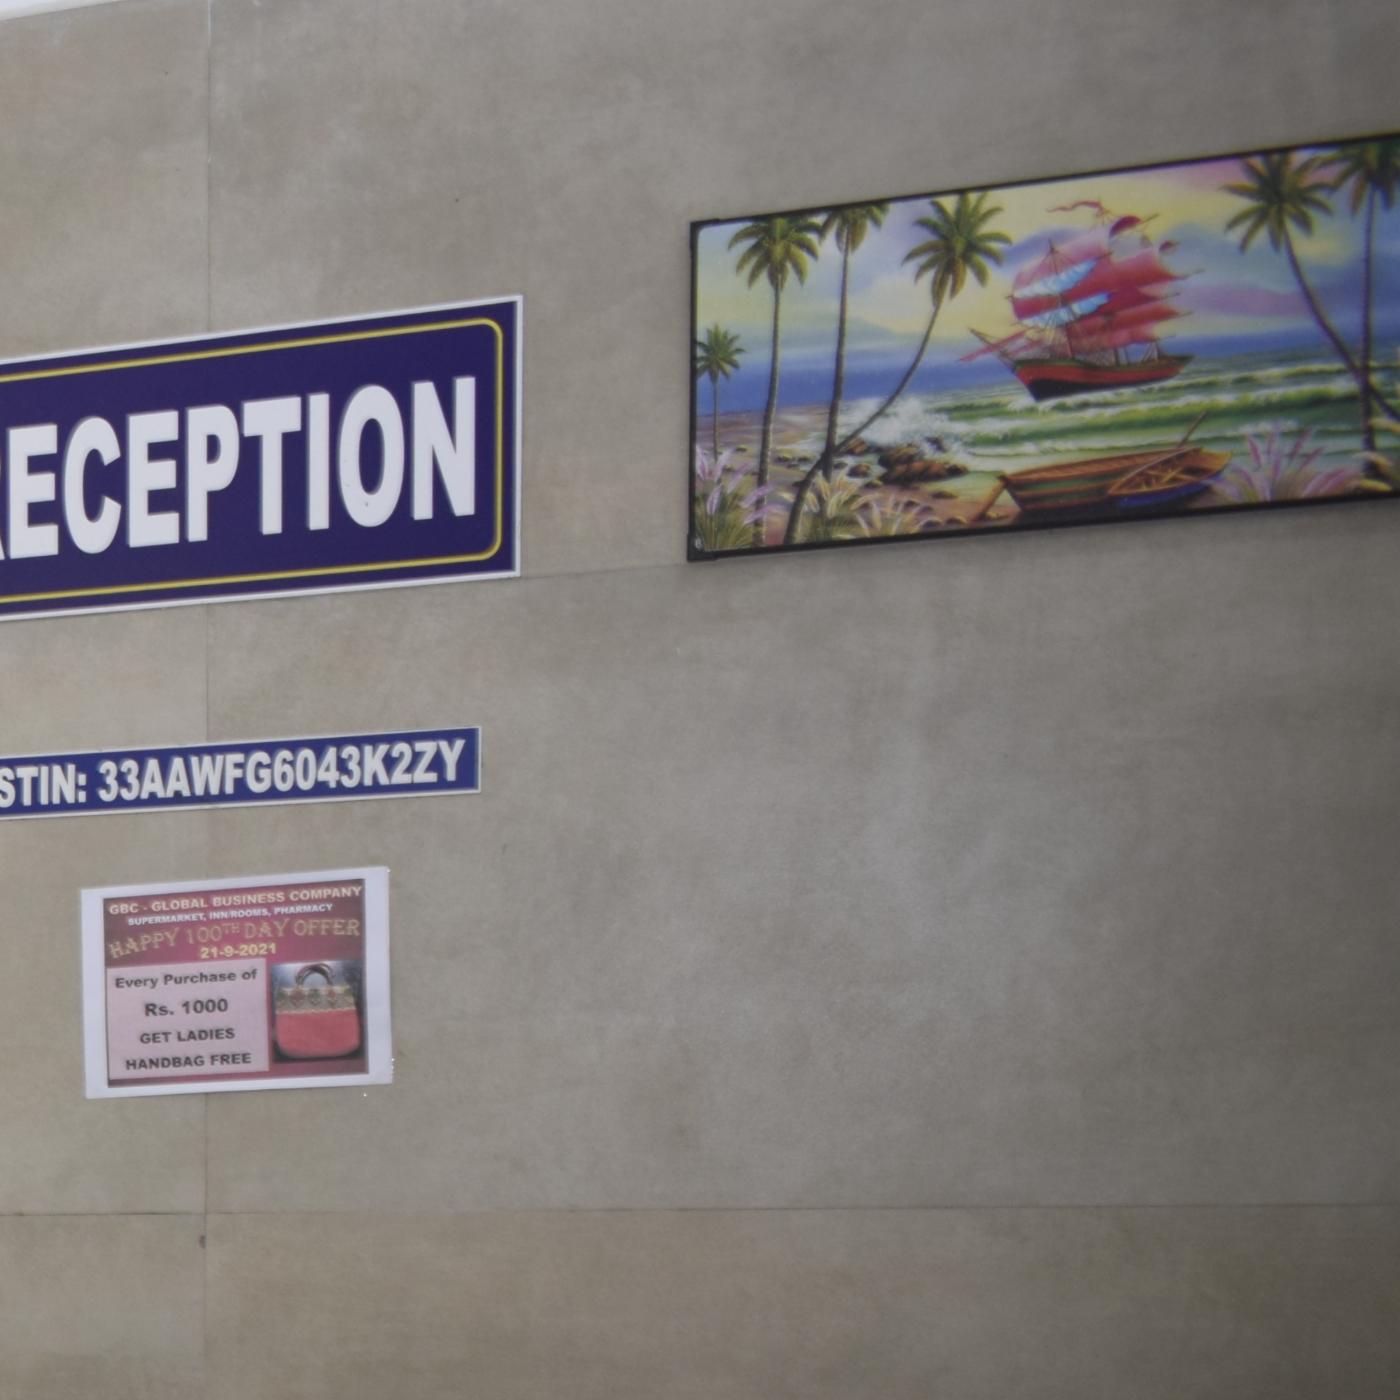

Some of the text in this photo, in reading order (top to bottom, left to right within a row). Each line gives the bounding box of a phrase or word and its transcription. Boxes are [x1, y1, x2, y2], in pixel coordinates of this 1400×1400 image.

[98, 738, 467, 803] 33AAWFG6043K2ZY
[109, 902, 139, 915] GBC
[151, 898, 208, 912] GLOBAL
[212, 891, 286, 907] BUSINESS
[289, 886, 363, 902] COMPANY
[274, 903, 334, 916] PHARMACY
[109, 926, 180, 959] HAPPY
[243, 918, 290, 939] DAY
[293, 917, 361, 937] OFFER
[200, 942, 277, 960] 21-9-2021
[114, 968, 258, 989] Every Purchase of
[144, 998, 229, 1017] Rs. 1000
[139, 1027, 236, 1044] GET LADIES
[125, 1052, 253, 1071] HANDBAG FREE
